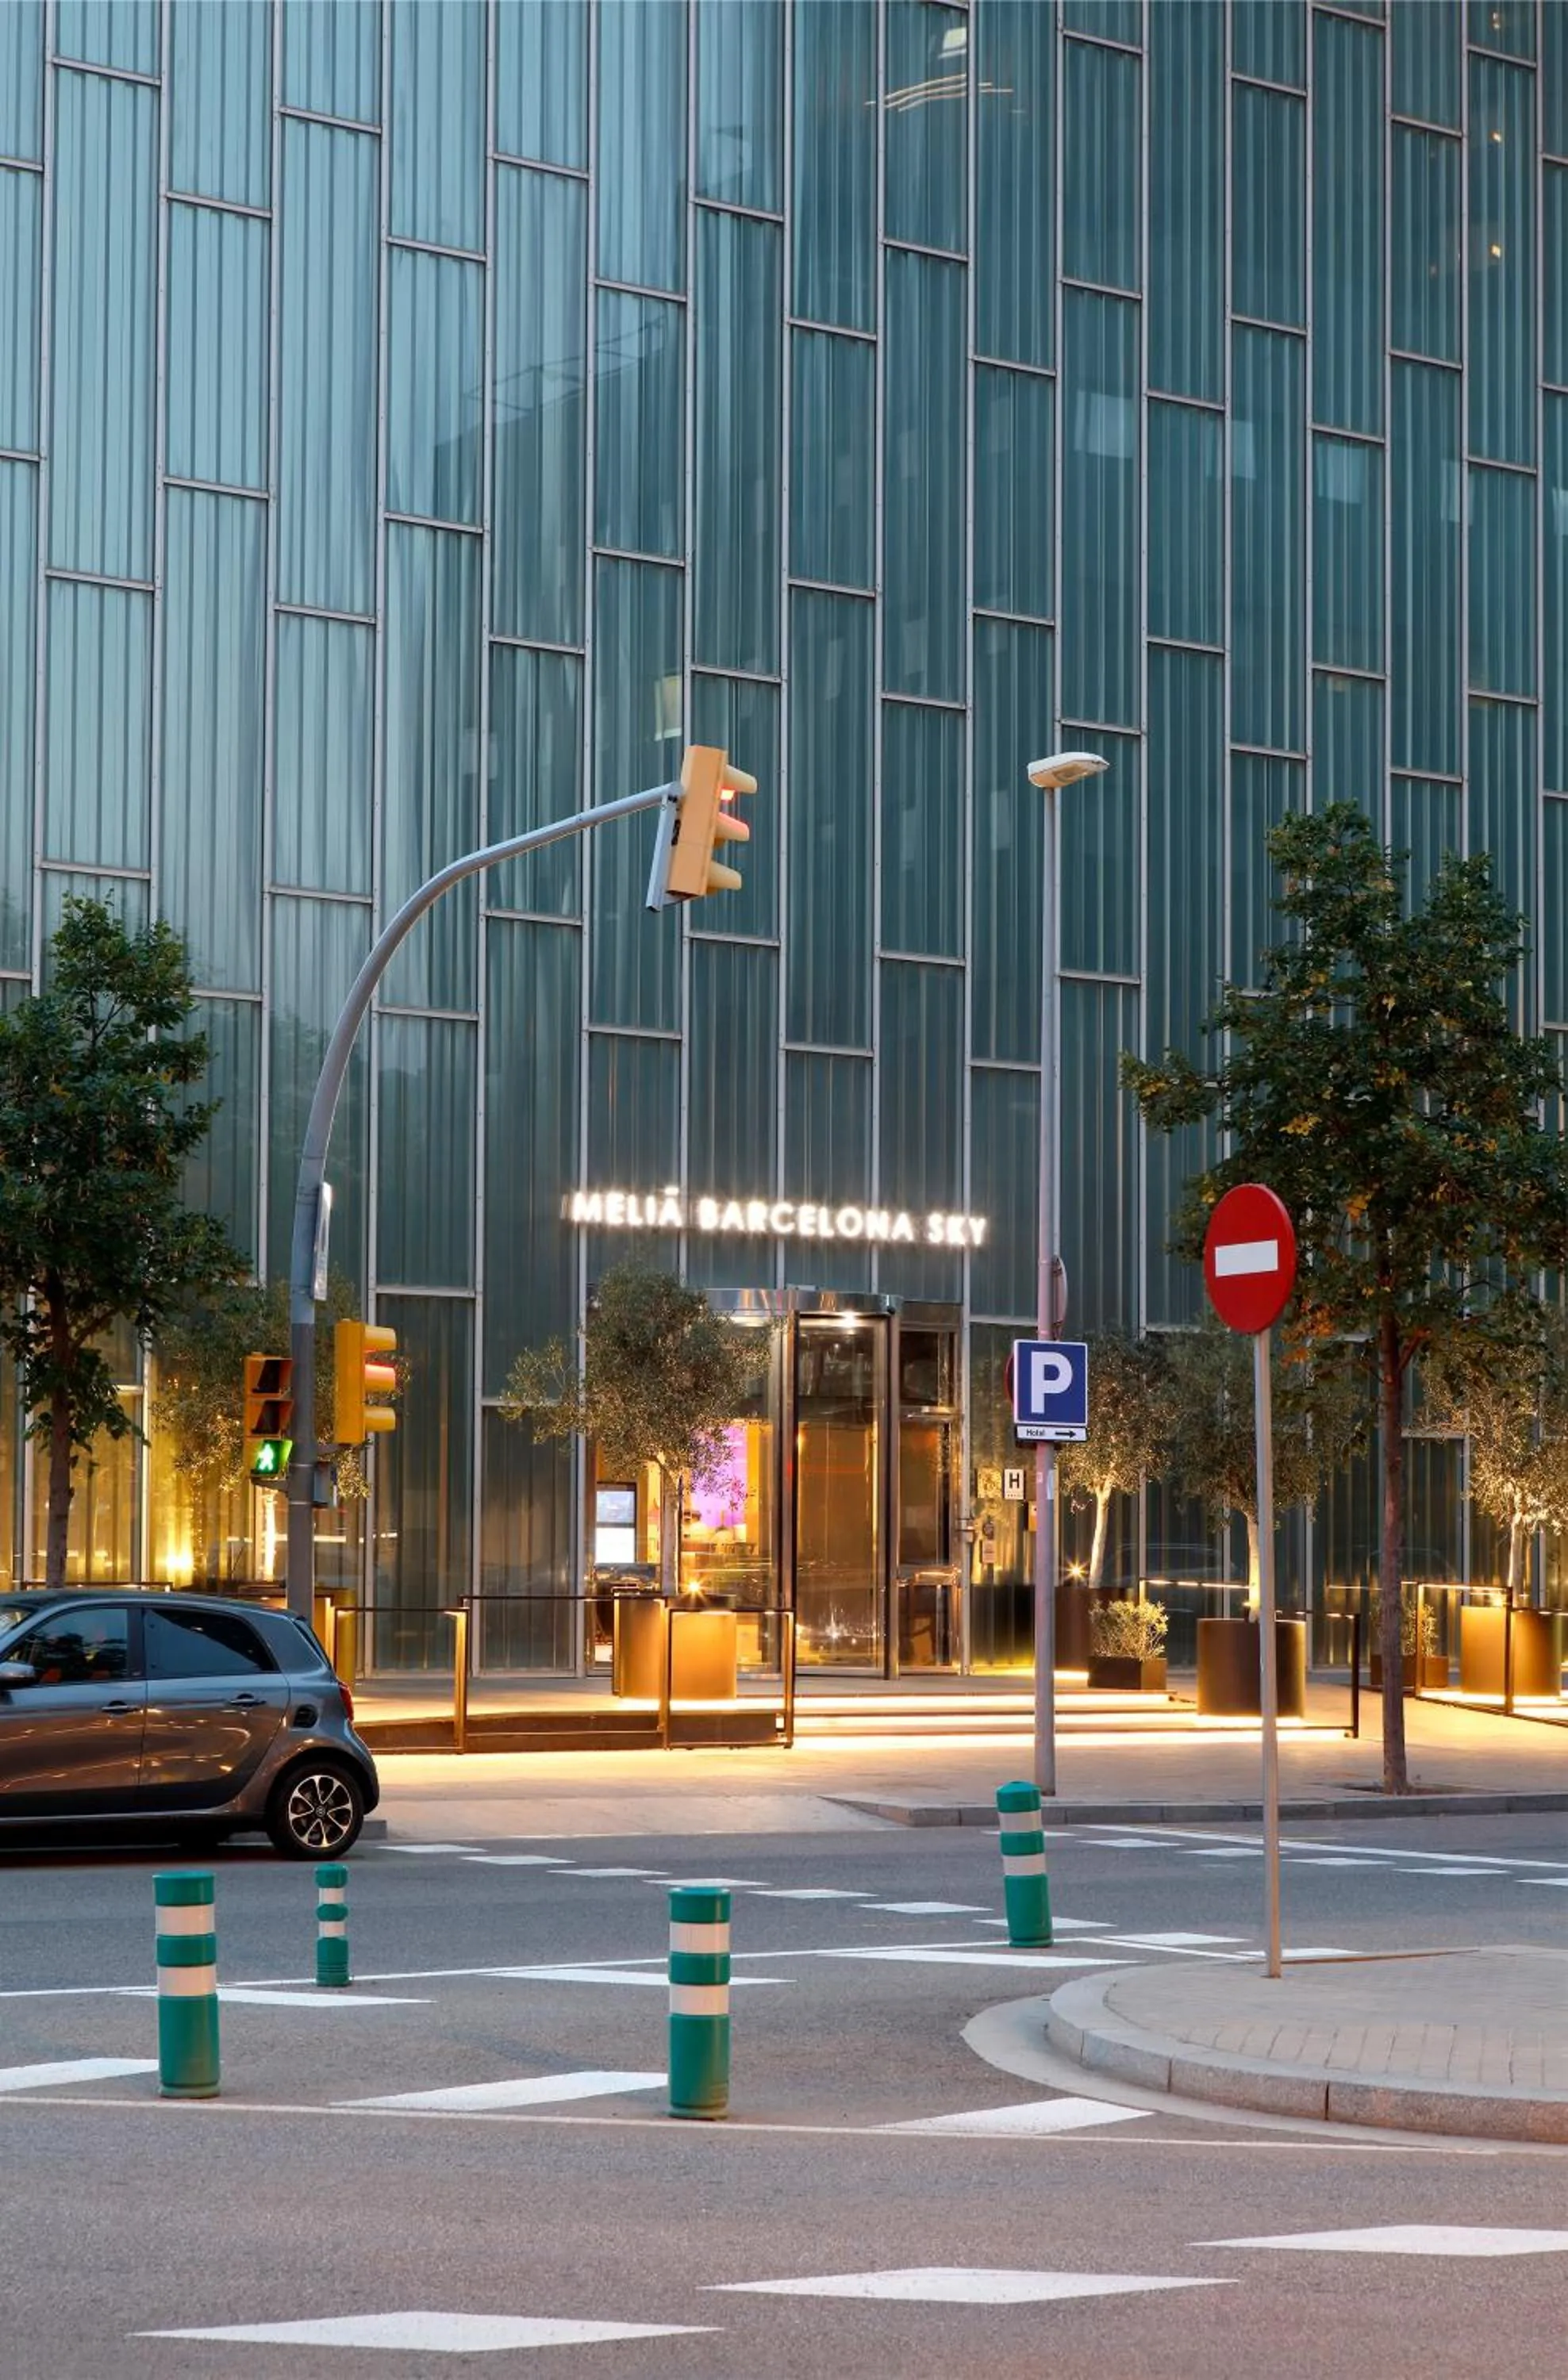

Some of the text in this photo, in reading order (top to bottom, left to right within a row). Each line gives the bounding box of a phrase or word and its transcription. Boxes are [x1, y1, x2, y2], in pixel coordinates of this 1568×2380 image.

[697, 1197, 914, 1242] BARCELONA
[928, 1212, 987, 1246] SKY
[1031, 1351, 1073, 1414] P
[1009, 1472, 1020, 1489] H
